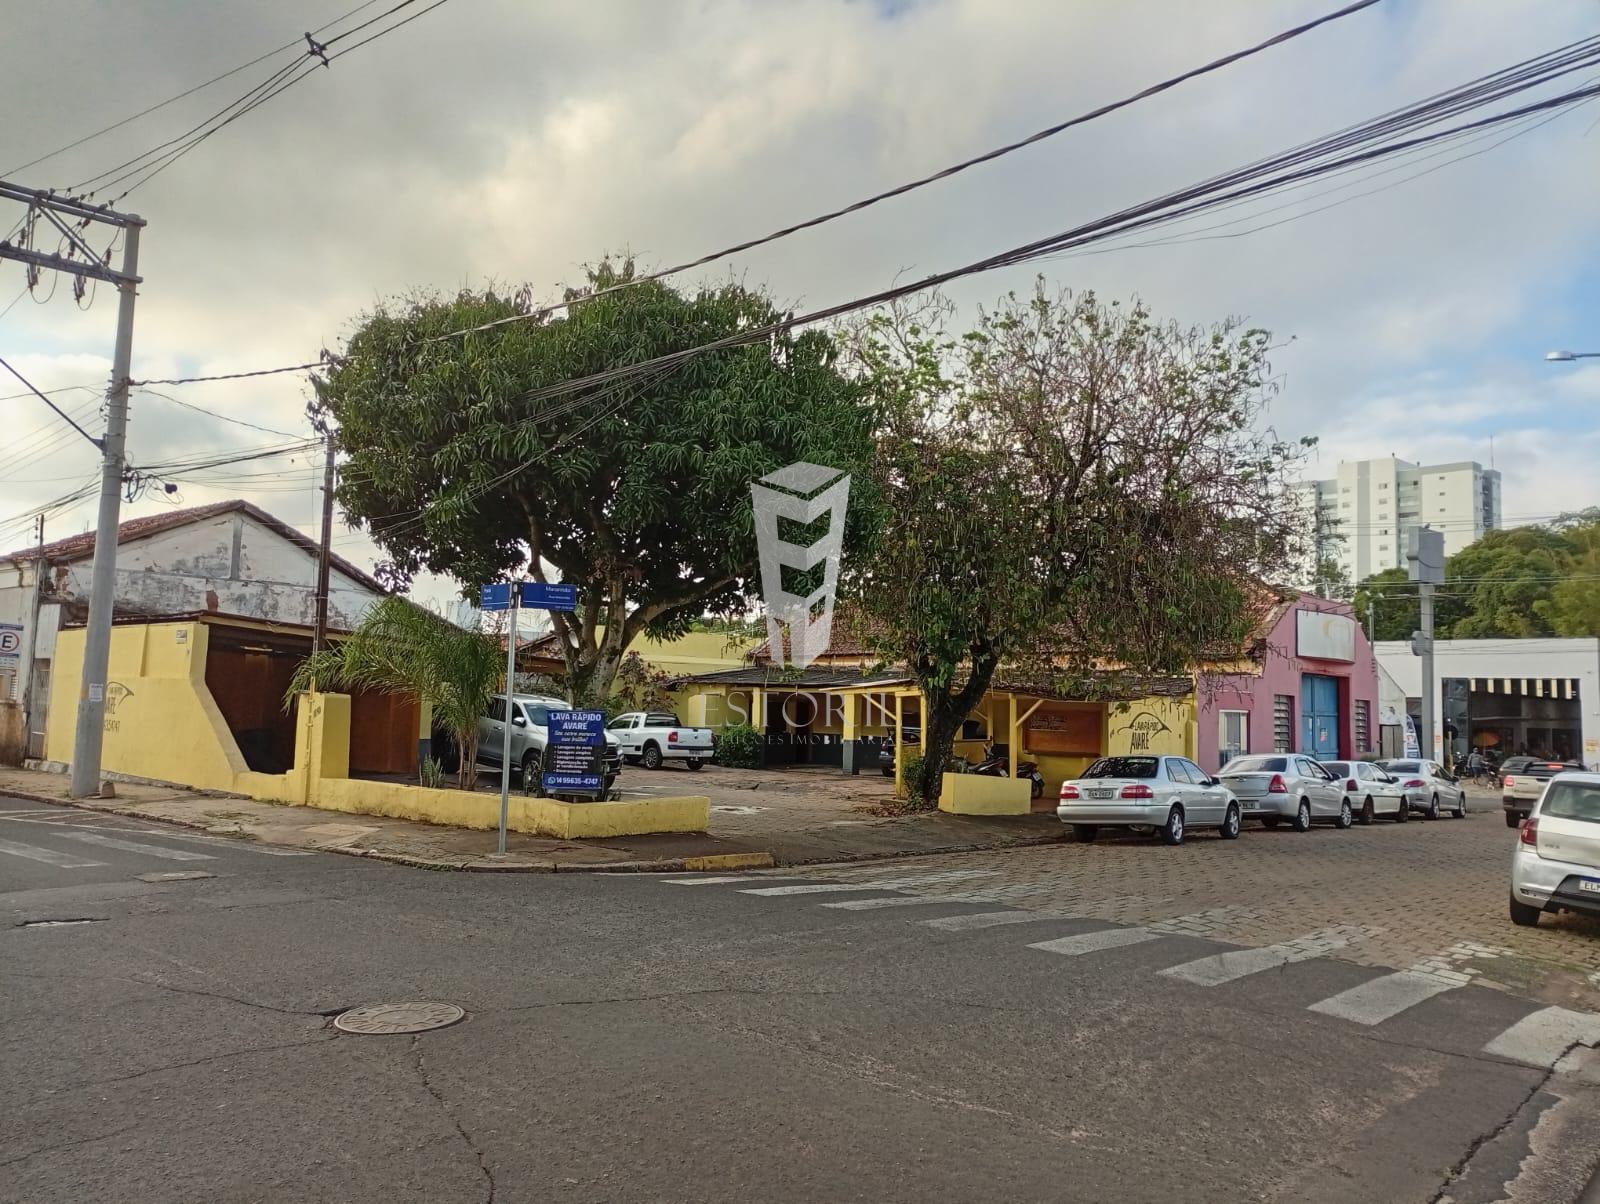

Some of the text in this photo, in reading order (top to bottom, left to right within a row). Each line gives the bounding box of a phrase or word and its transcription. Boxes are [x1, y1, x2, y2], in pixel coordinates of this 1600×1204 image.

[2, 635, 13, 649] E
[572, 712, 601, 721] RÁPIDO
[562, 721, 588, 730] AVARÉ
